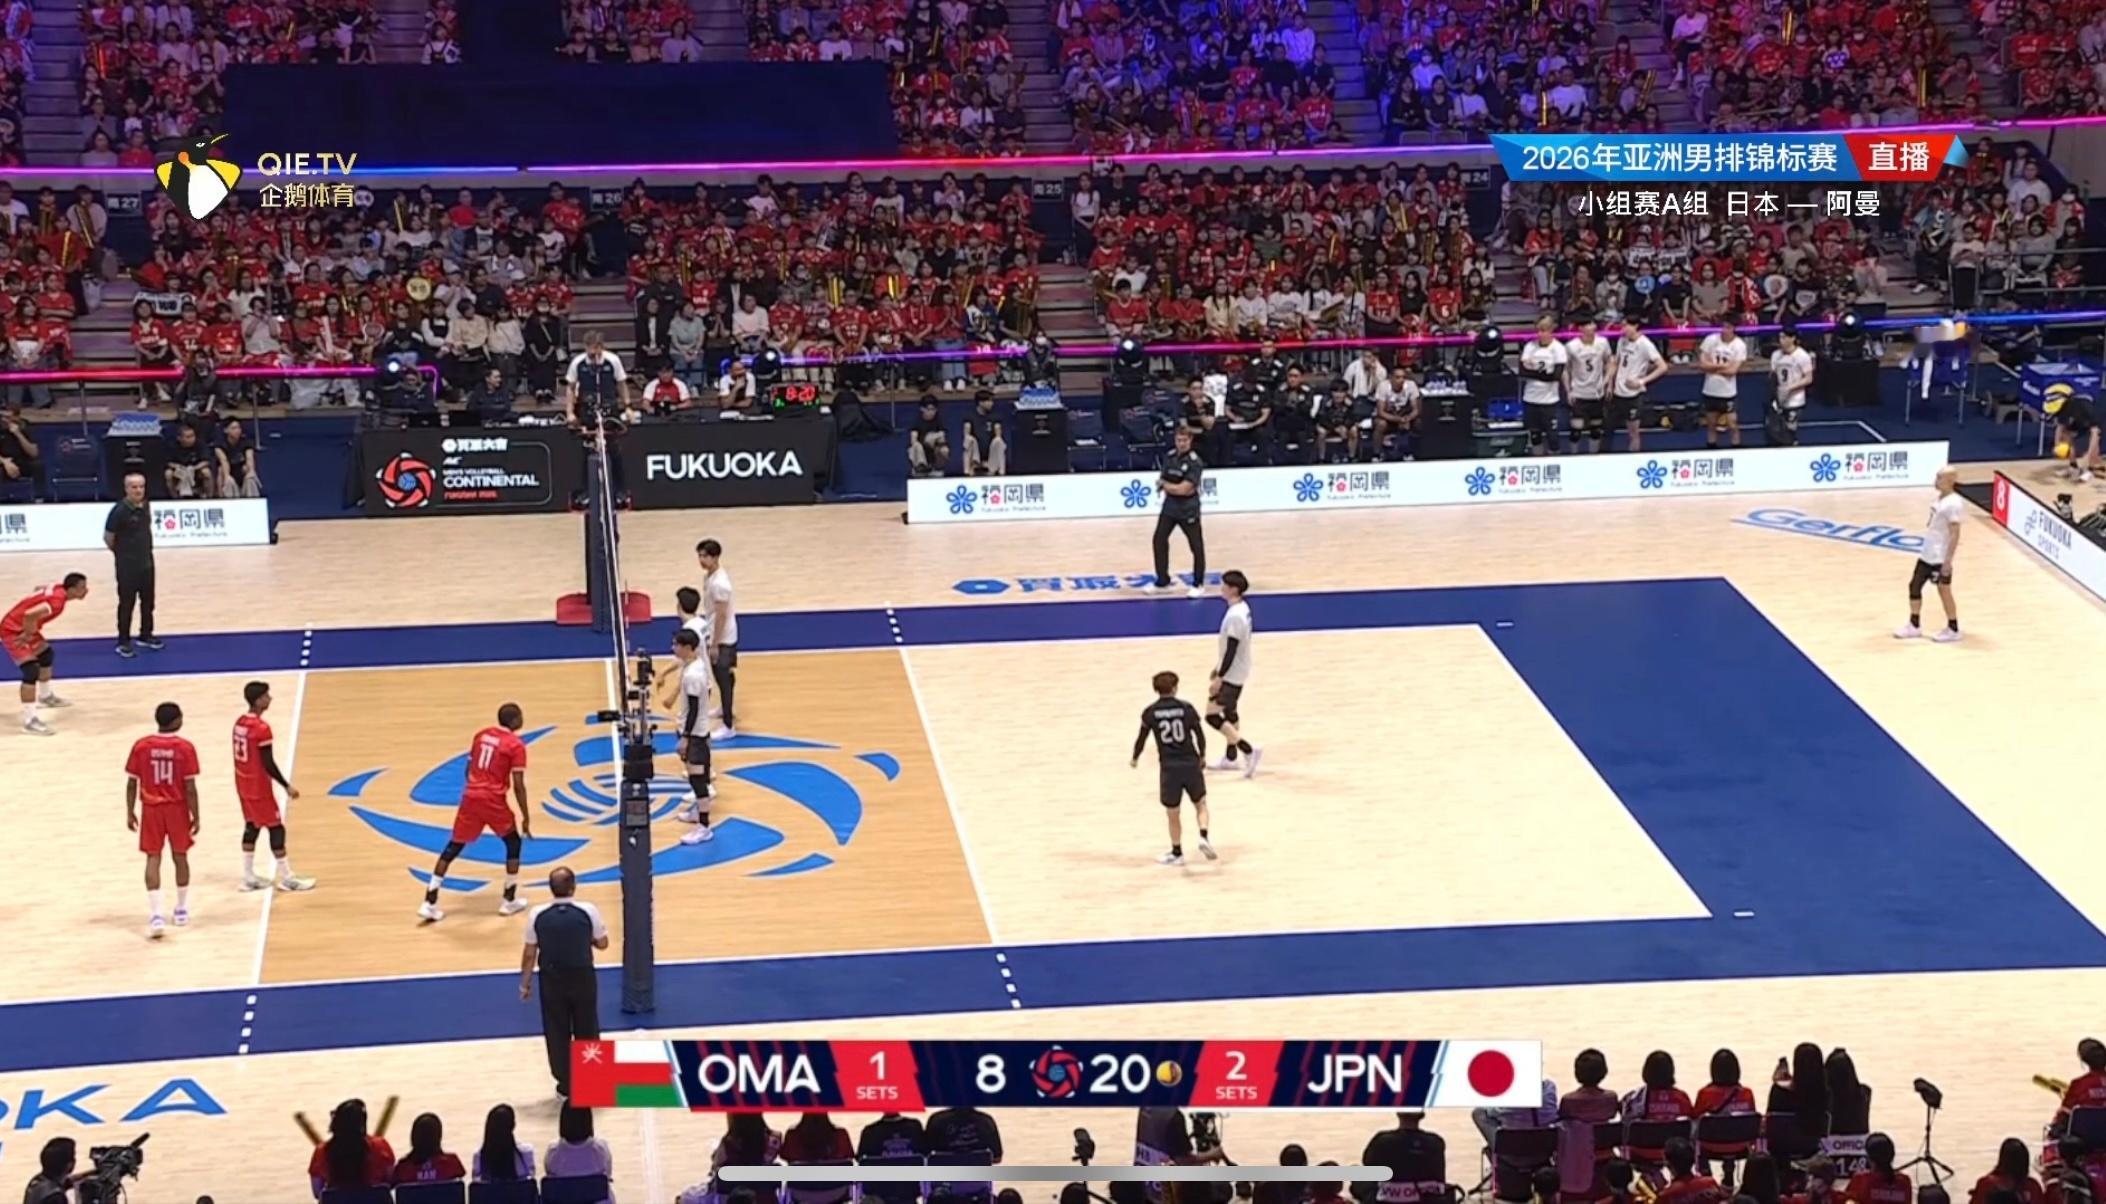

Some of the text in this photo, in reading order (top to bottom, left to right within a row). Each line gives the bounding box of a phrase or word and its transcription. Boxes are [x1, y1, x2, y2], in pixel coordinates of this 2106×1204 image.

[1585, 359, 1594, 372] 5
[1781, 368, 1789, 382] 9
[646, 451, 804, 480] FUKUOKA
[443, 475, 539, 488] CONTINENTAL
[1994, 479, 2005, 511] 8
[2039, 510, 2072, 550] FUKUOKA
[1159, 719, 1185, 743] 20
[478, 743, 494, 769] 11
[150, 759, 173, 785] 14
[0, 1078, 228, 1130] KA
